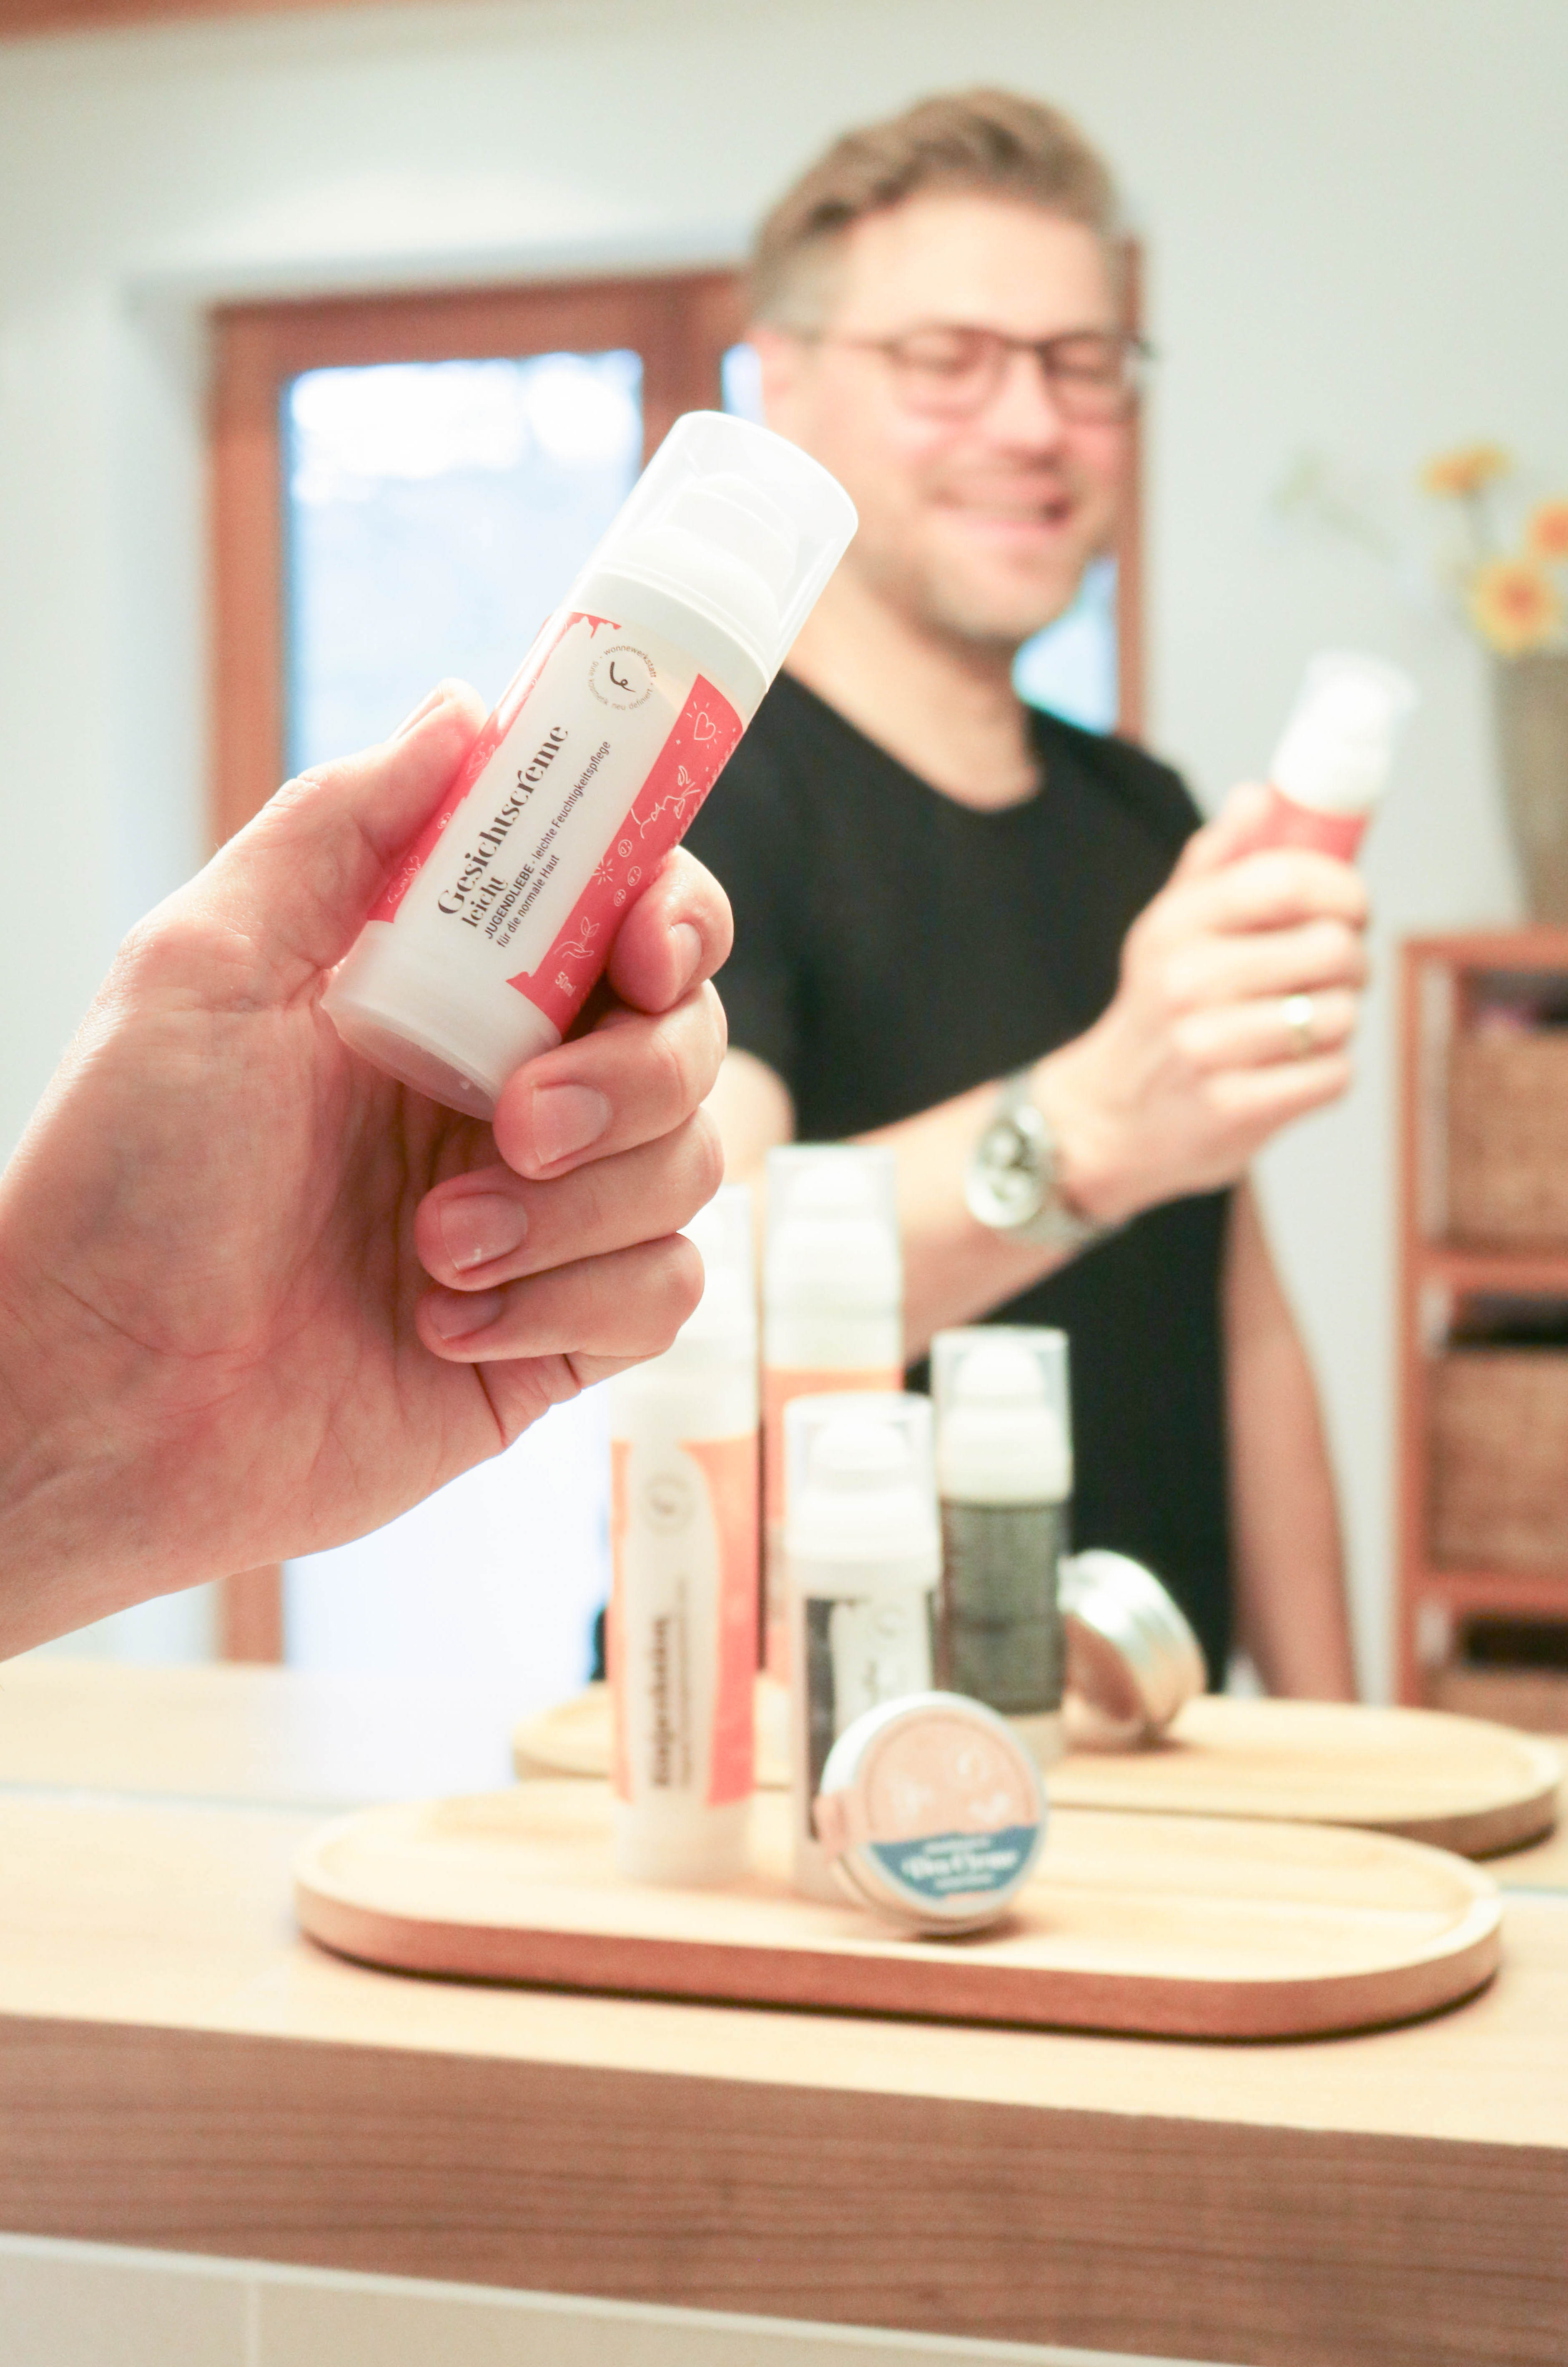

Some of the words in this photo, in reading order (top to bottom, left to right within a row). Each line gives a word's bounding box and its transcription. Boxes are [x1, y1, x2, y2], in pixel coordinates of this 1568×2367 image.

[604, 645, 656, 677] wonnewerkstatt
[629, 689, 652, 710] definiert
[484, 863, 535, 940] JUGENDLIEBE
[531, 828, 558, 860] leichte
[551, 741, 611, 829] Feuchtigkeitspflege
[460, 876, 509, 929] leicht
[496, 932, 512, 948] für
[507, 917, 522, 933] die
[517, 878, 546, 918] normale
[539, 854, 560, 879] Haut
